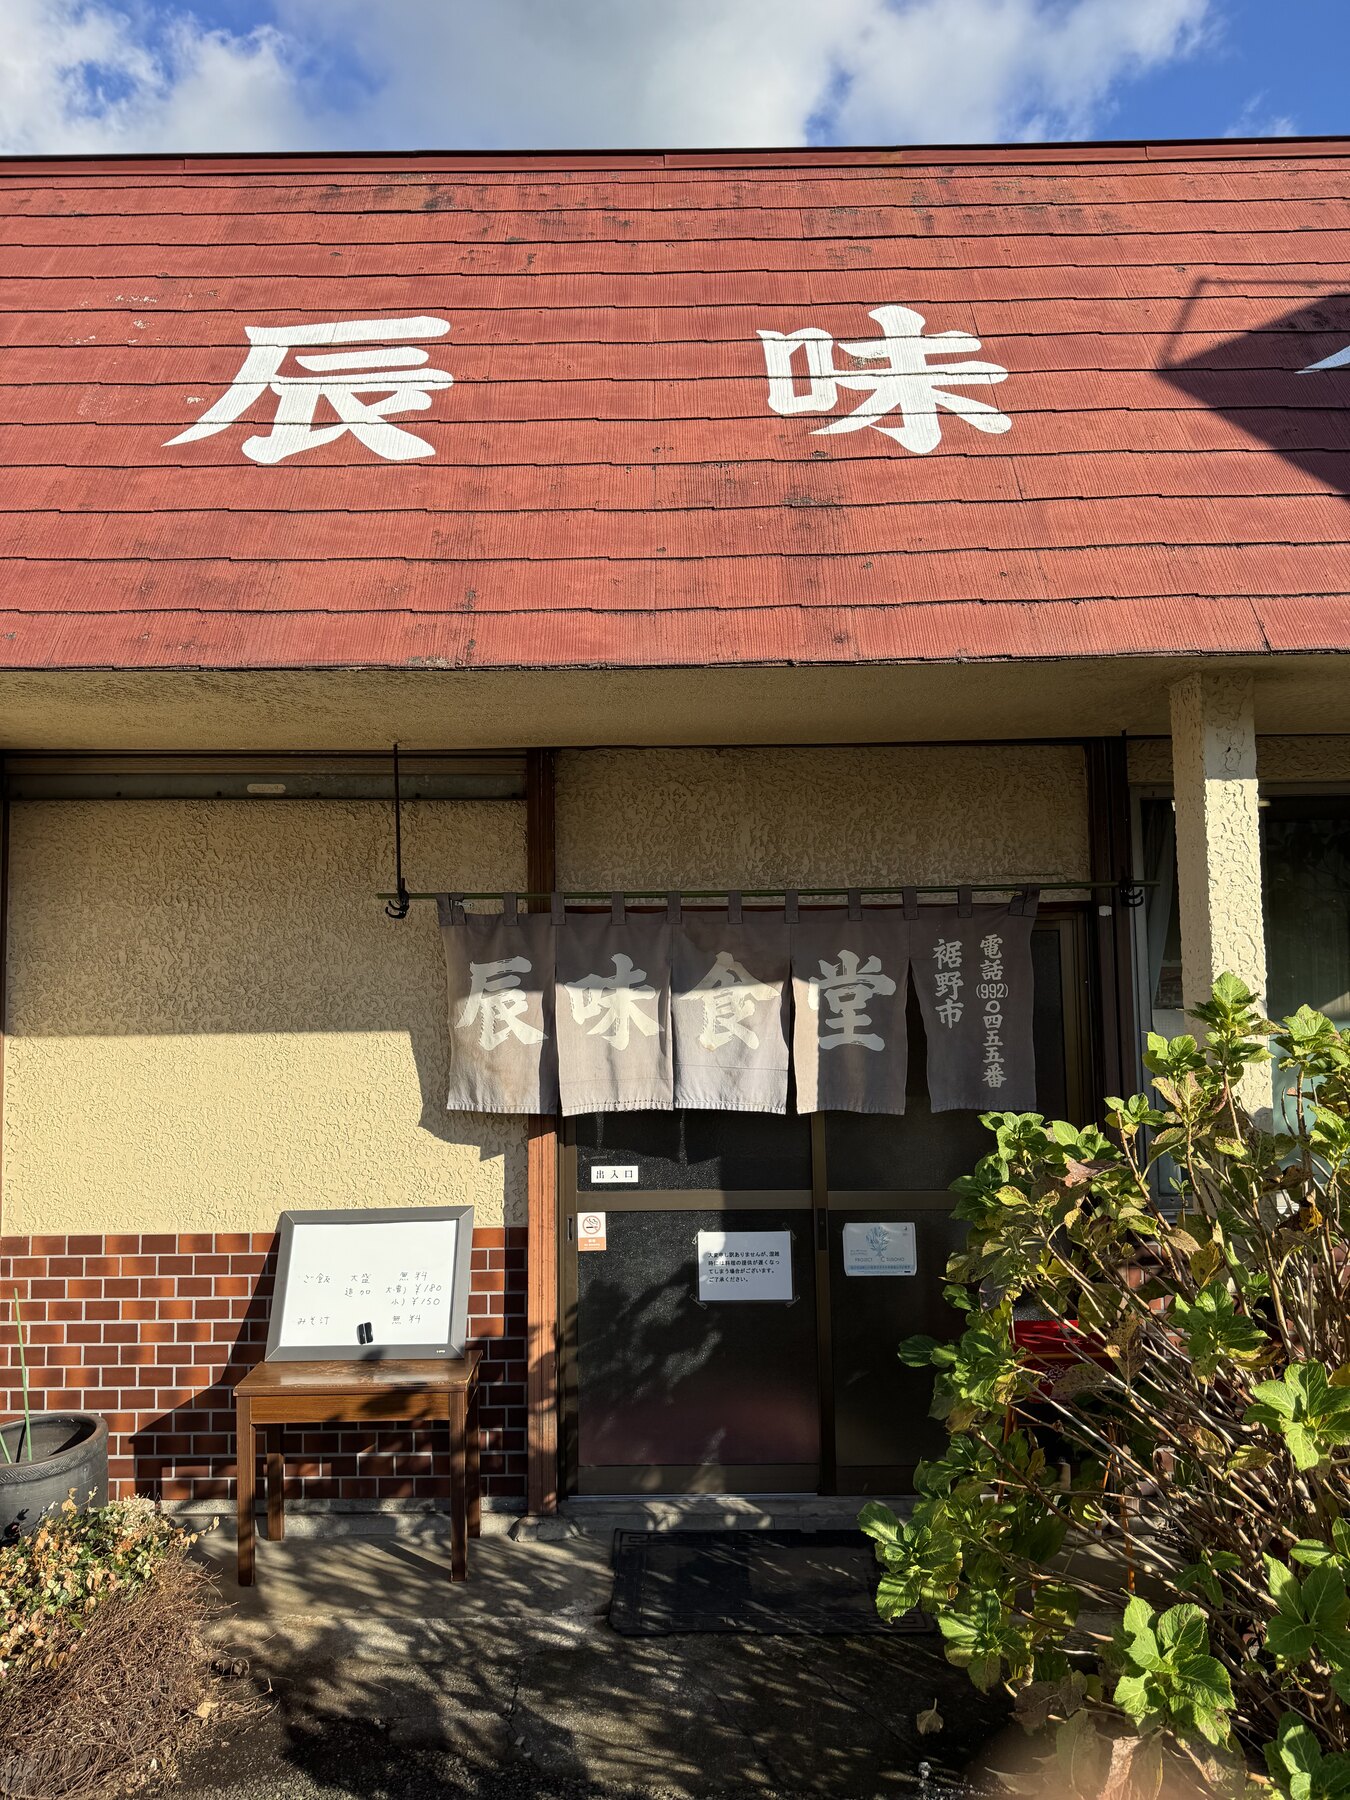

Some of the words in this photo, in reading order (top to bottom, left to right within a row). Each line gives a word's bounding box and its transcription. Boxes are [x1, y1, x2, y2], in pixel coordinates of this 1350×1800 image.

[455, 949, 896, 1052] 辰味食堂
[932, 937, 964, 1030] 裾野市
[596, 1169, 633, 1179] 出入口
